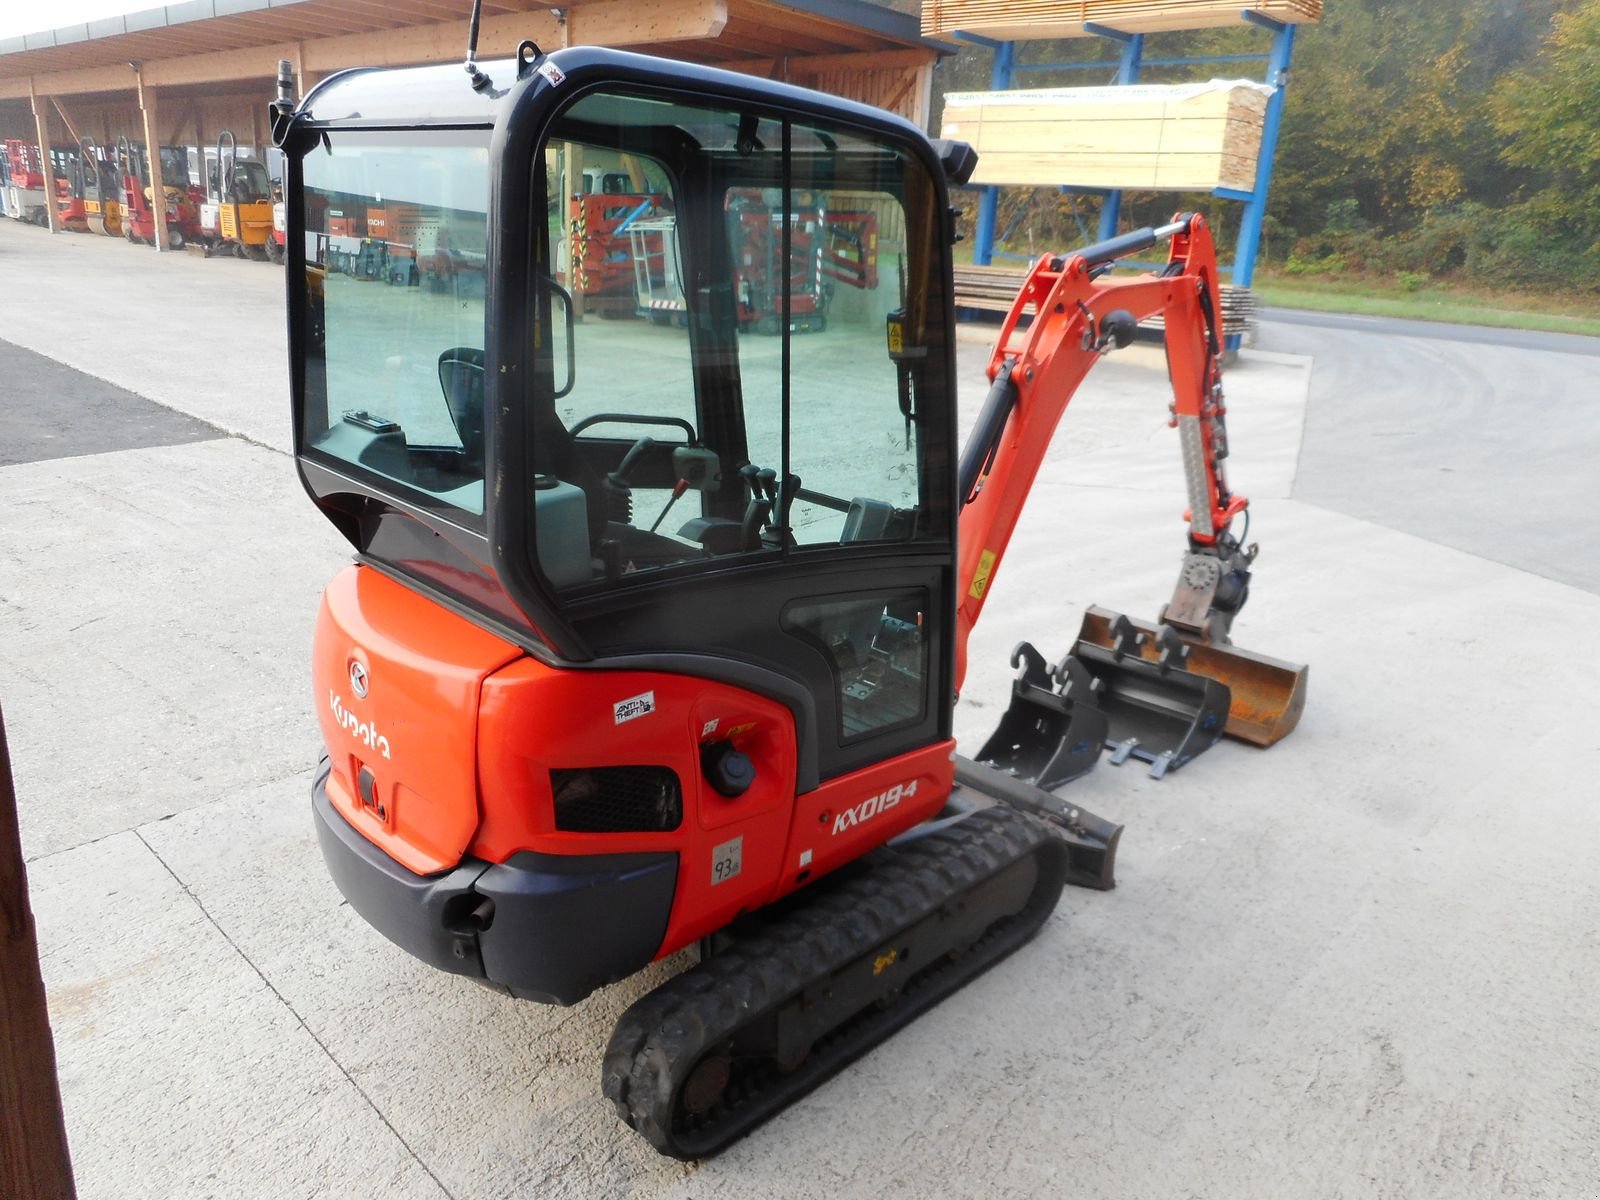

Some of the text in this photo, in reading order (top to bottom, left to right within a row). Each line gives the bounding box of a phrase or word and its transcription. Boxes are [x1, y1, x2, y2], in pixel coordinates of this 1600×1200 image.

[329, 688, 390, 760] Kubota
[615, 705, 640, 719] THEFT
[831, 779, 918, 836] KX019-4
[715, 858, 732, 881] 93
